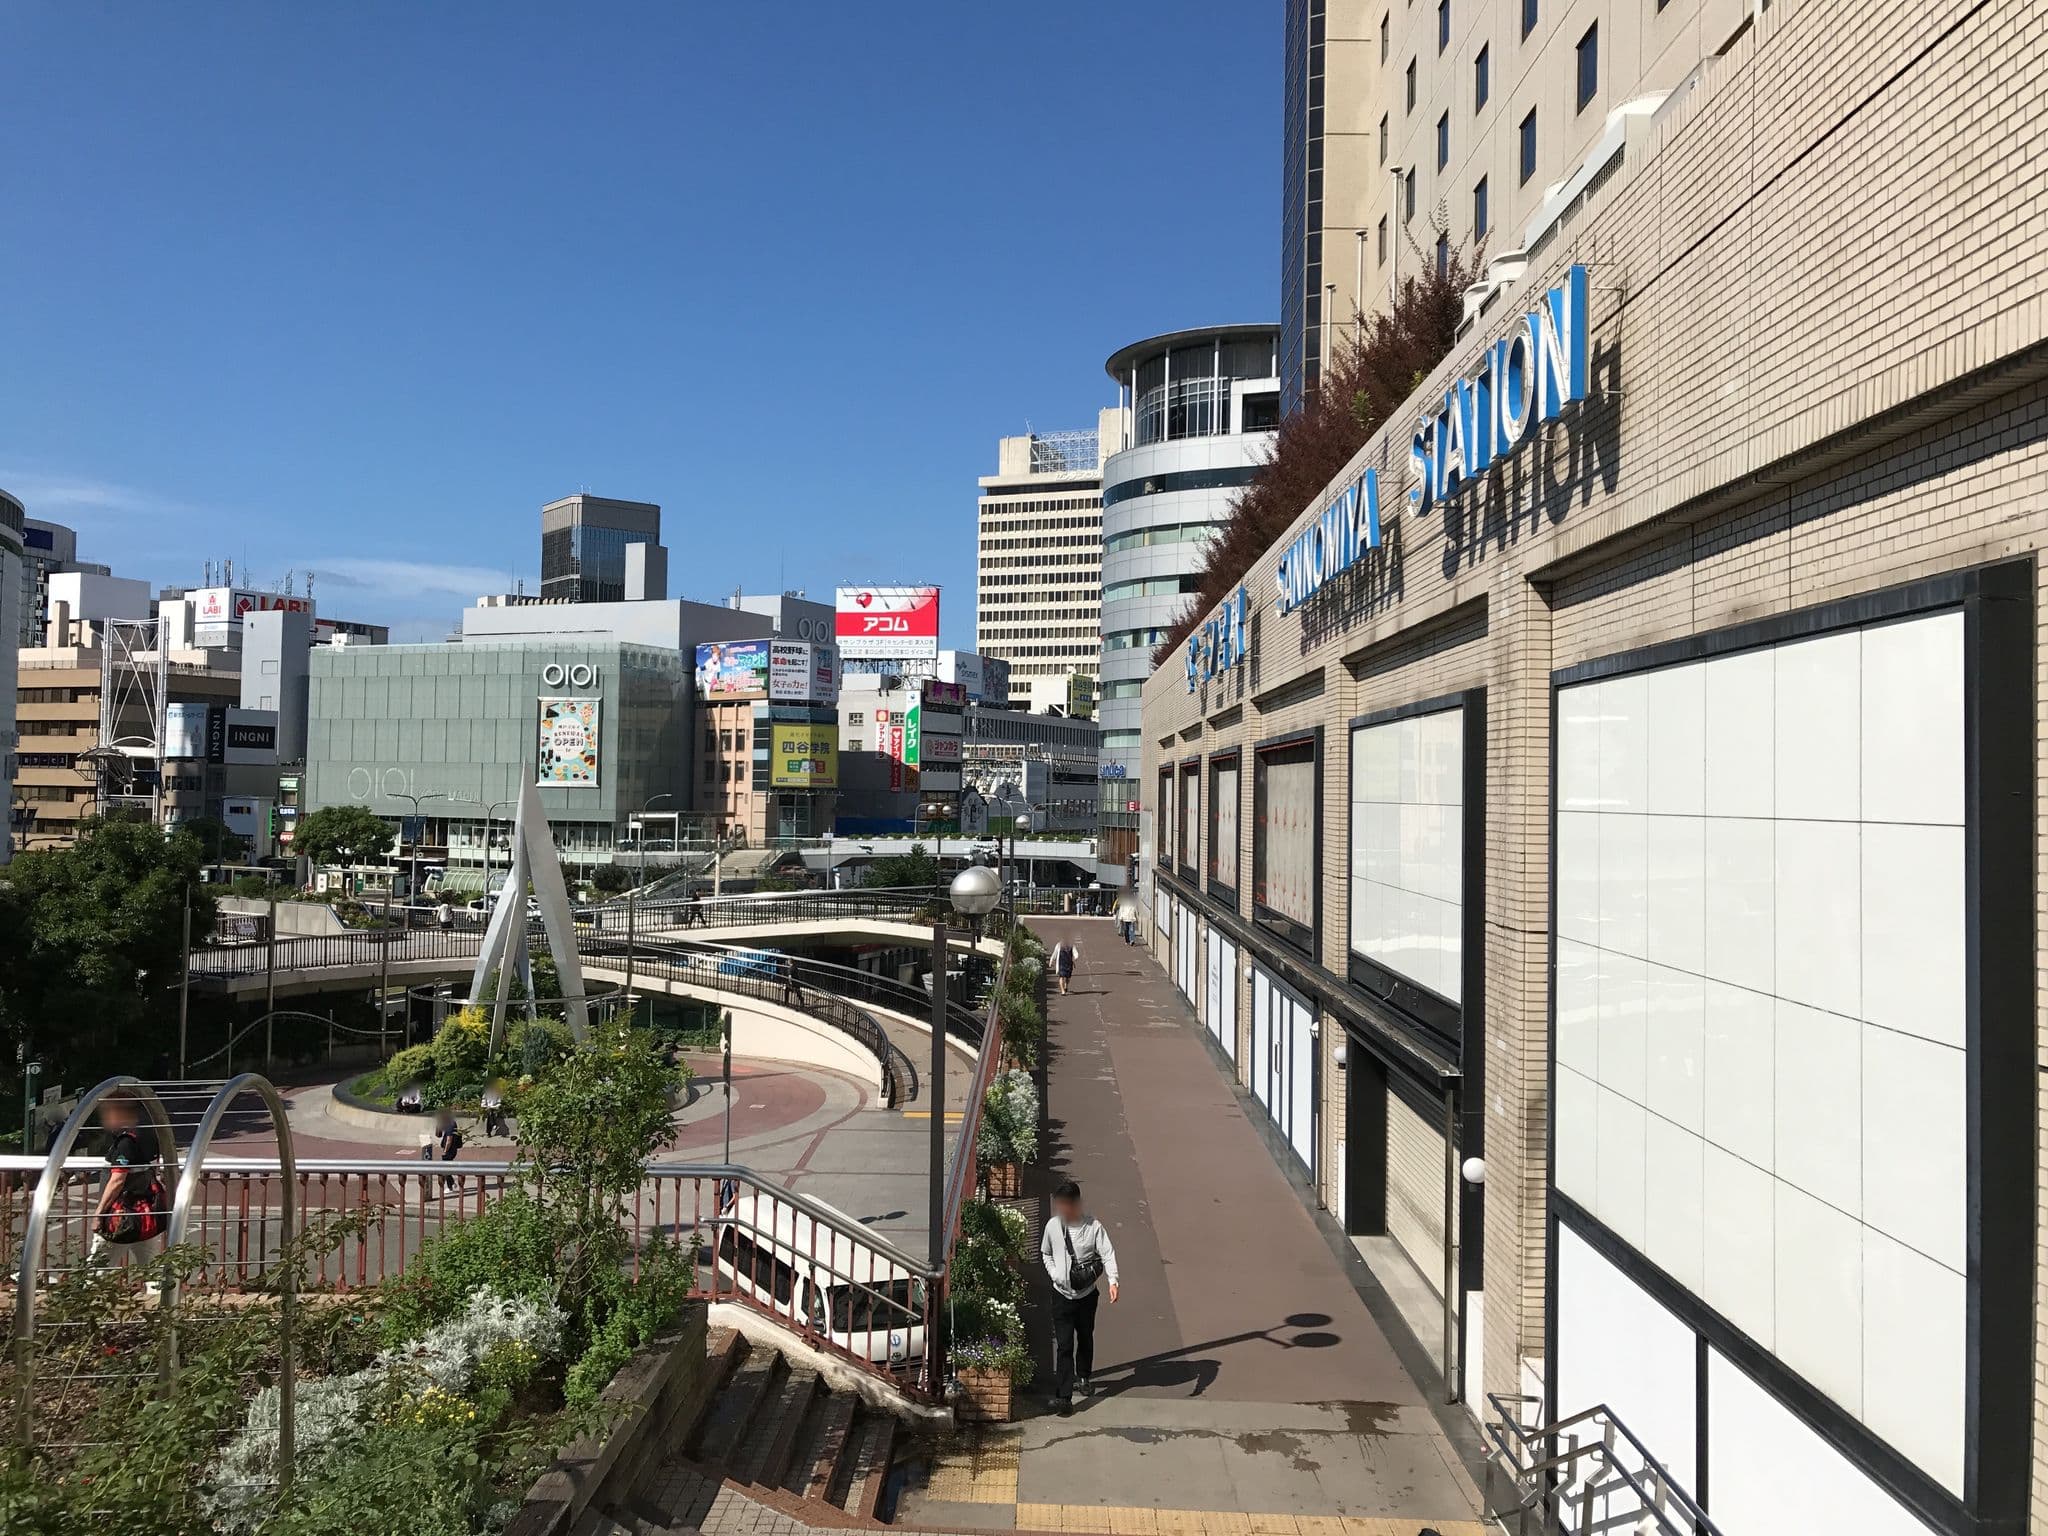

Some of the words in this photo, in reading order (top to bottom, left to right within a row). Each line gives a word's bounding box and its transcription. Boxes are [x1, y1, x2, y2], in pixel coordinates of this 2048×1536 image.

[1275, 468, 1381, 619] SANNOMIYA
[1406, 264, 1591, 519] STATION
[202, 605, 222, 615] LABI
[862, 616, 909, 632] アコム
[211, 714, 221, 758] INGNI
[233, 731, 270, 742] INGNI
[907, 718, 916, 749] レイク
[554, 738, 584, 747] OPEN
[782, 740, 830, 755] 四谷学院
